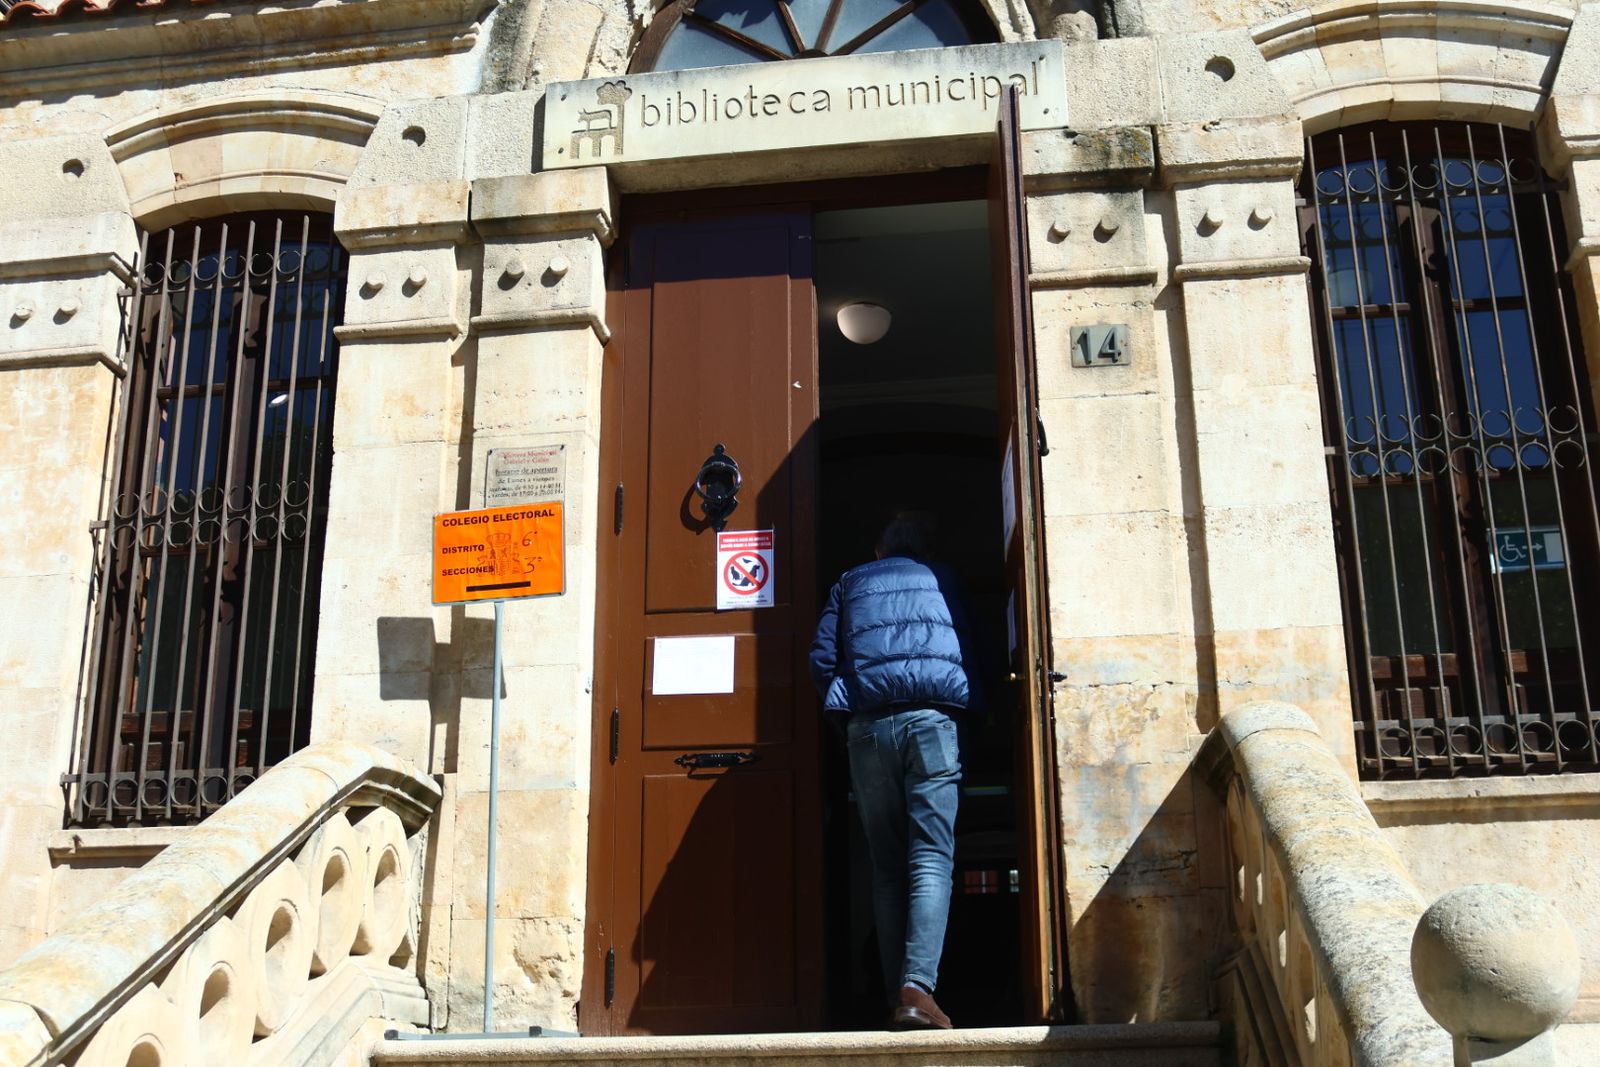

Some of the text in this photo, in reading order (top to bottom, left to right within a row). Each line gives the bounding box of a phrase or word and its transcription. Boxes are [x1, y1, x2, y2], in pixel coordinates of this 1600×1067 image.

[641, 61, 1041, 129] biblioteca municipal
[1077, 327, 1122, 365] 14
[442, 509, 555, 527] COLEGIO ELECTORAL
[442, 544, 485, 554] DISTRITO
[442, 565, 495, 577] SECCIONES
